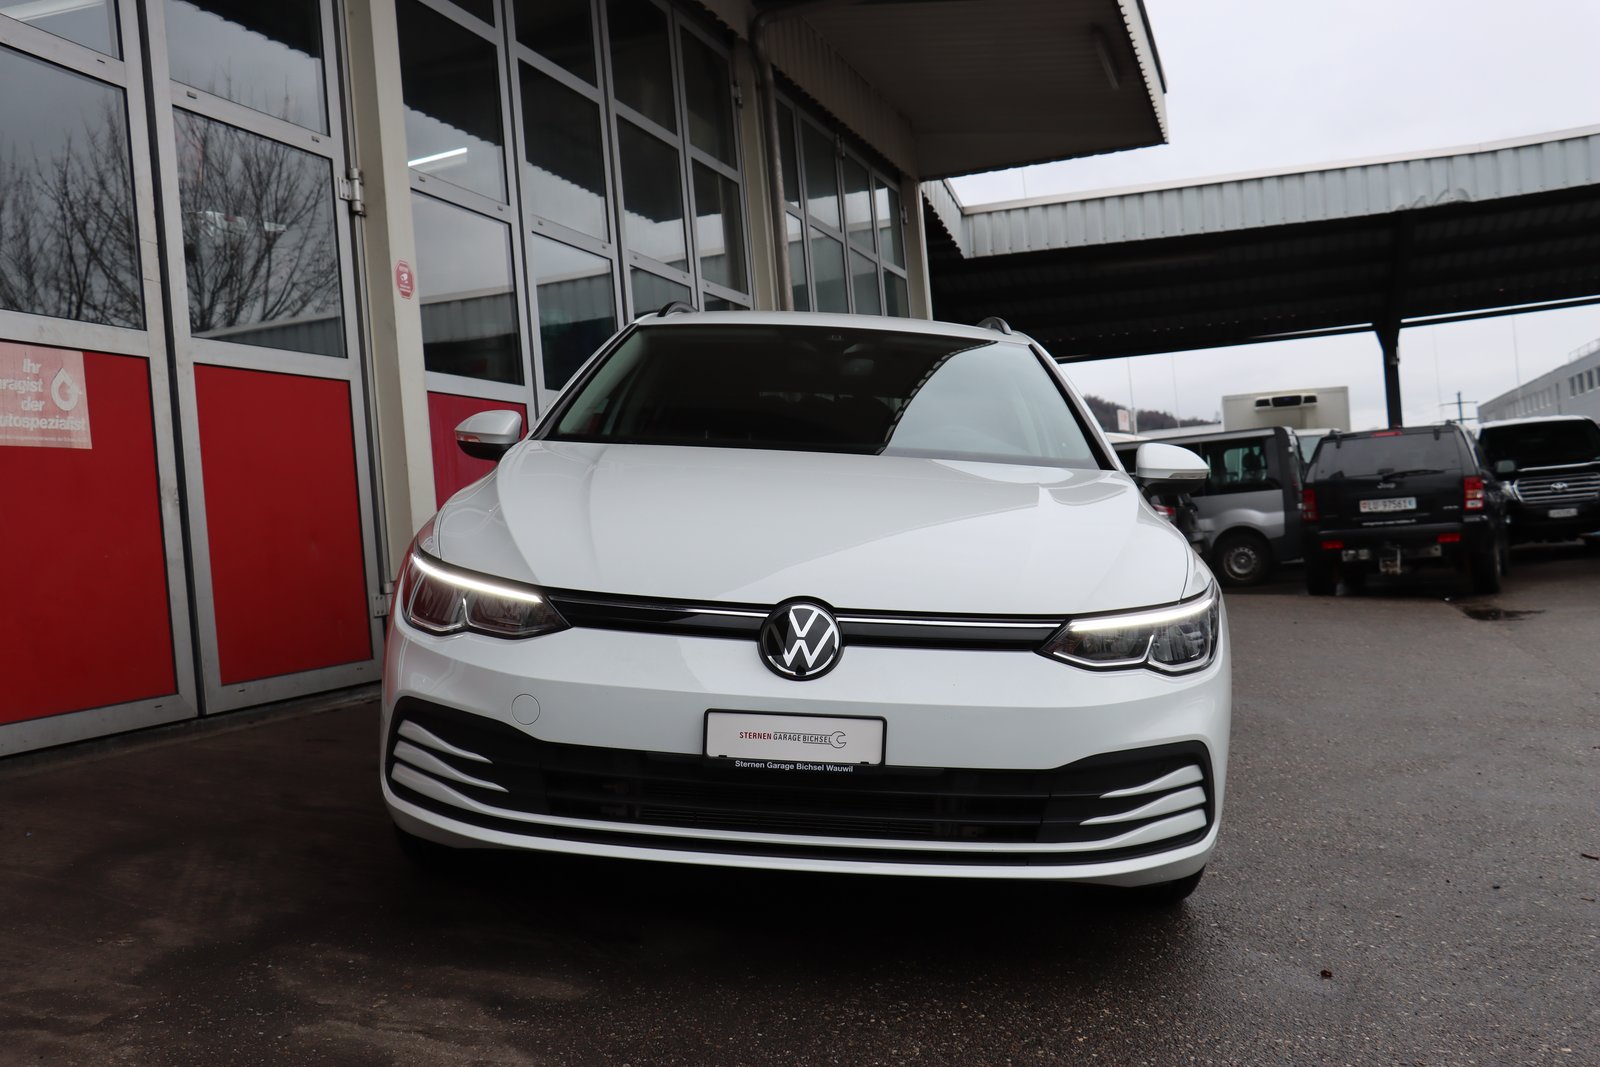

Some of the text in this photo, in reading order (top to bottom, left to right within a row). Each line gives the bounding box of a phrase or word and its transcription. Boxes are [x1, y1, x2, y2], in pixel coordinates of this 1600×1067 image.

[22, 358, 41, 374] Ihr
[21, 397, 45, 411] der
[739, 731, 832, 744] STERNEN GARAGE BICHSEL
[735, 760, 854, 773] Sternen Garage Bichsel Wauwil
